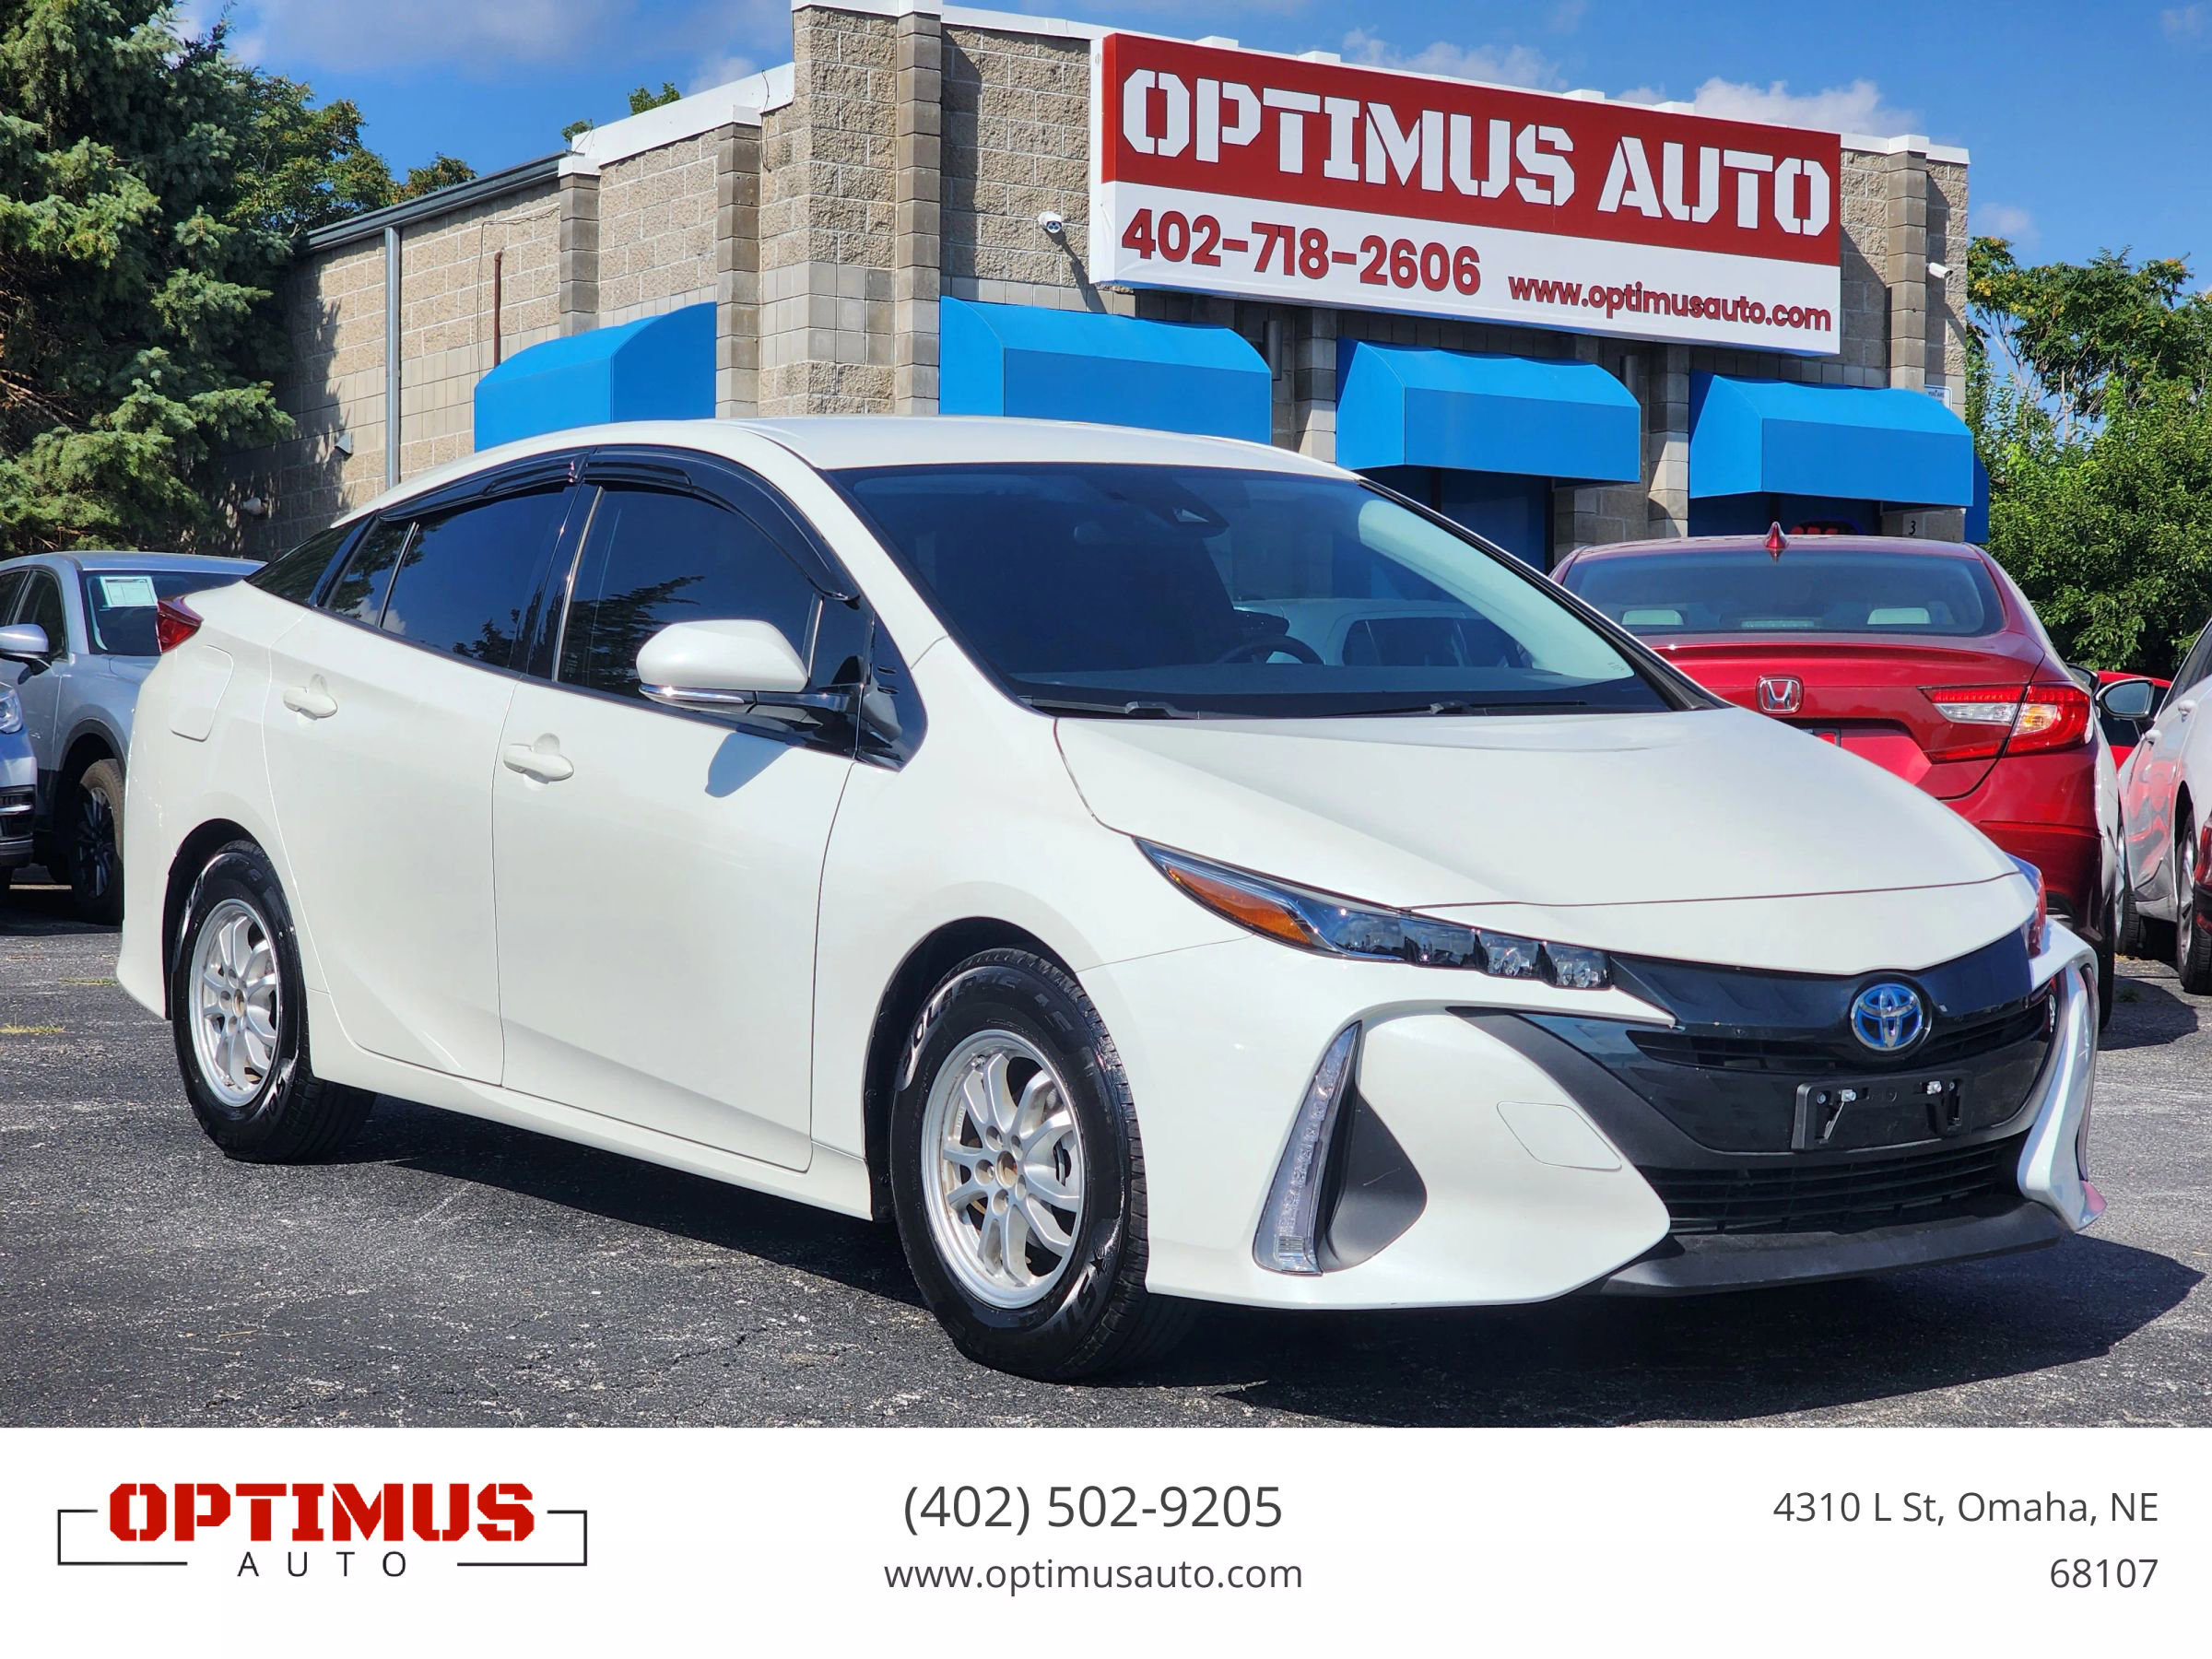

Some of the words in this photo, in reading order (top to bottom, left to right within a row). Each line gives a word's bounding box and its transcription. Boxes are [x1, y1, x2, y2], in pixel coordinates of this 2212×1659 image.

[1123, 68, 1575, 206] OPTIMUS
[1596, 135, 1830, 236] AUTO
[1121, 207, 1481, 296] 402-718-2606
[1509, 276, 1831, 332] www.optimusauto.com
